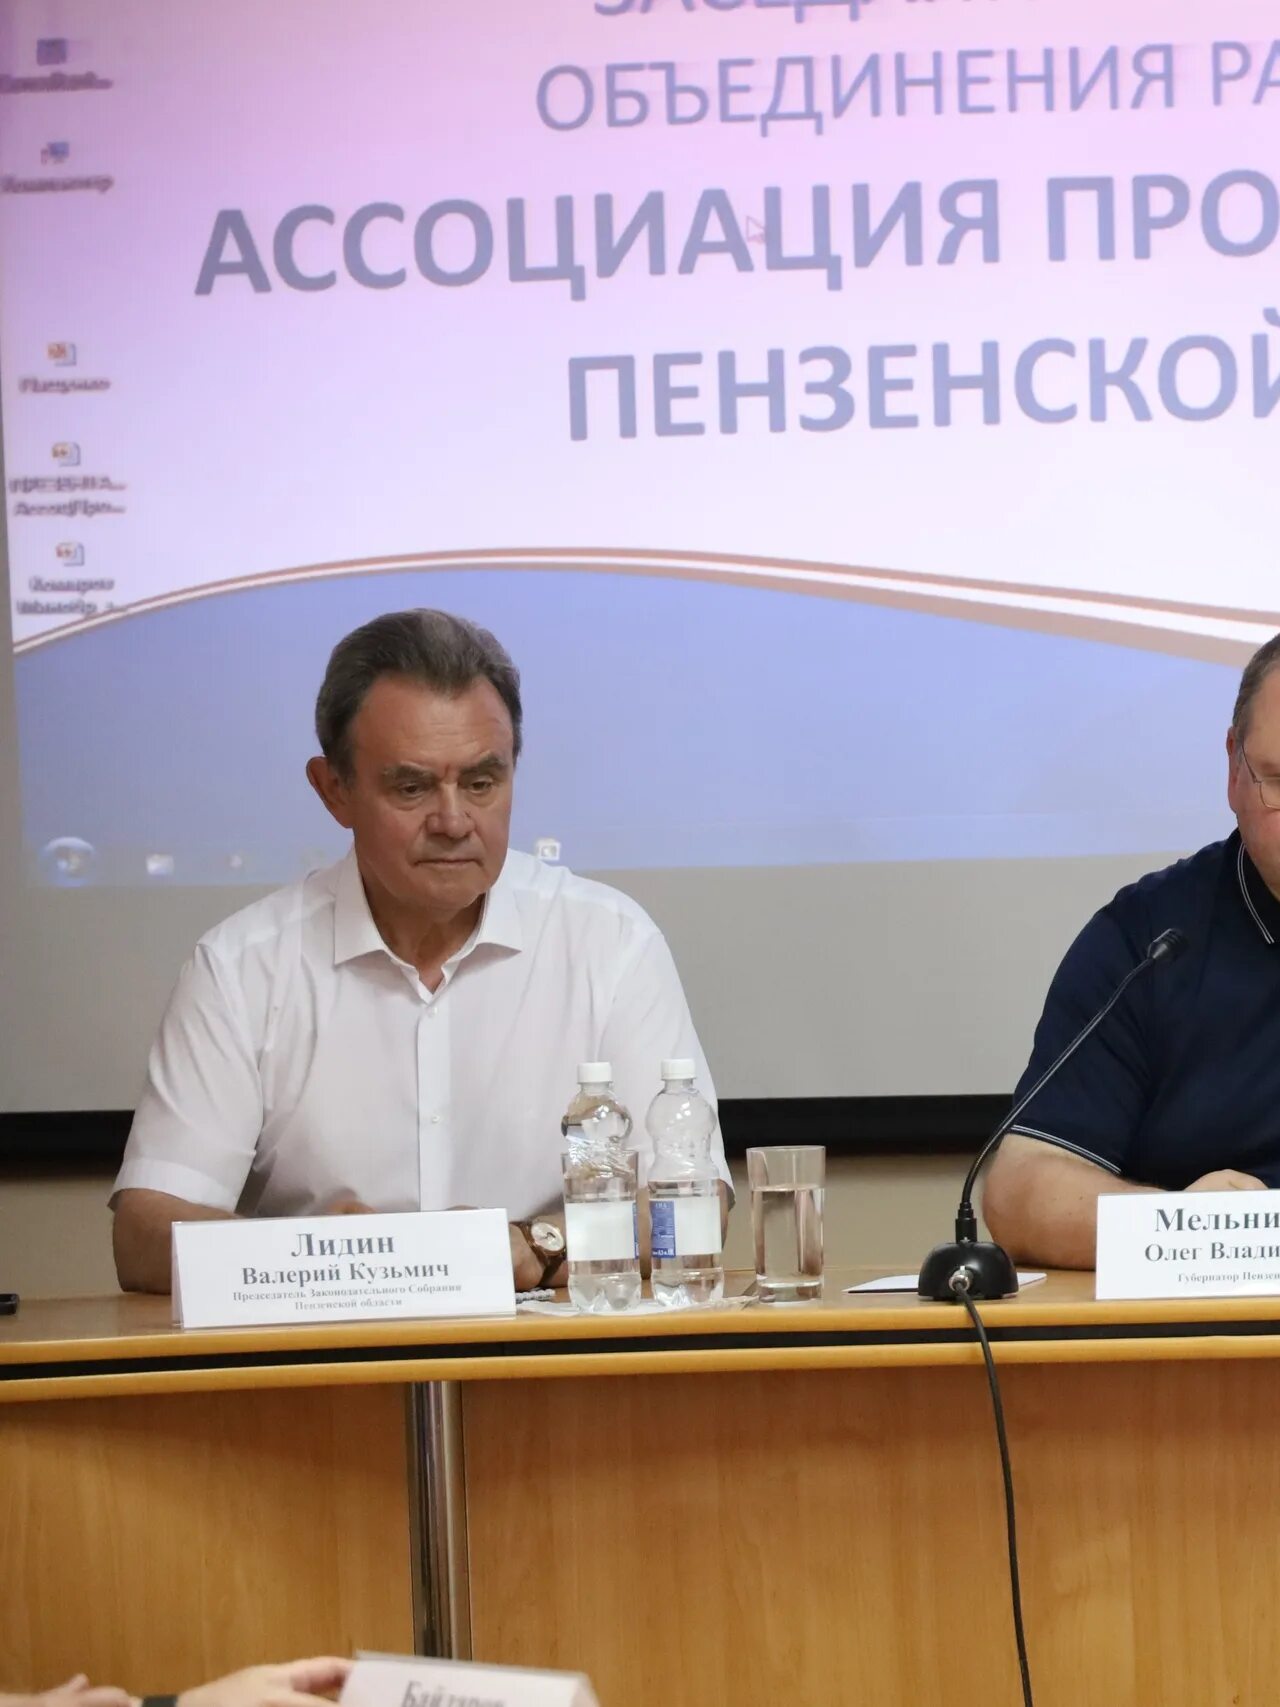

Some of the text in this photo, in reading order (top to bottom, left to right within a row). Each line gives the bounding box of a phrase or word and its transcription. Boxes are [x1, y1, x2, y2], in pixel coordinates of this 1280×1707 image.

[535, 43, 1175, 139] ОБЪЕДИНЕНИЯ
[193, 178, 1000, 301] АССОЦИАЦИЯ
[290, 1233, 394, 1258] Лидин
[1144, 1243, 1203, 1262] Олег
[242, 1262, 450, 1288] Валерий Кузьмич
[232, 1283, 462, 1305] Председатель Законодательного Собрания
